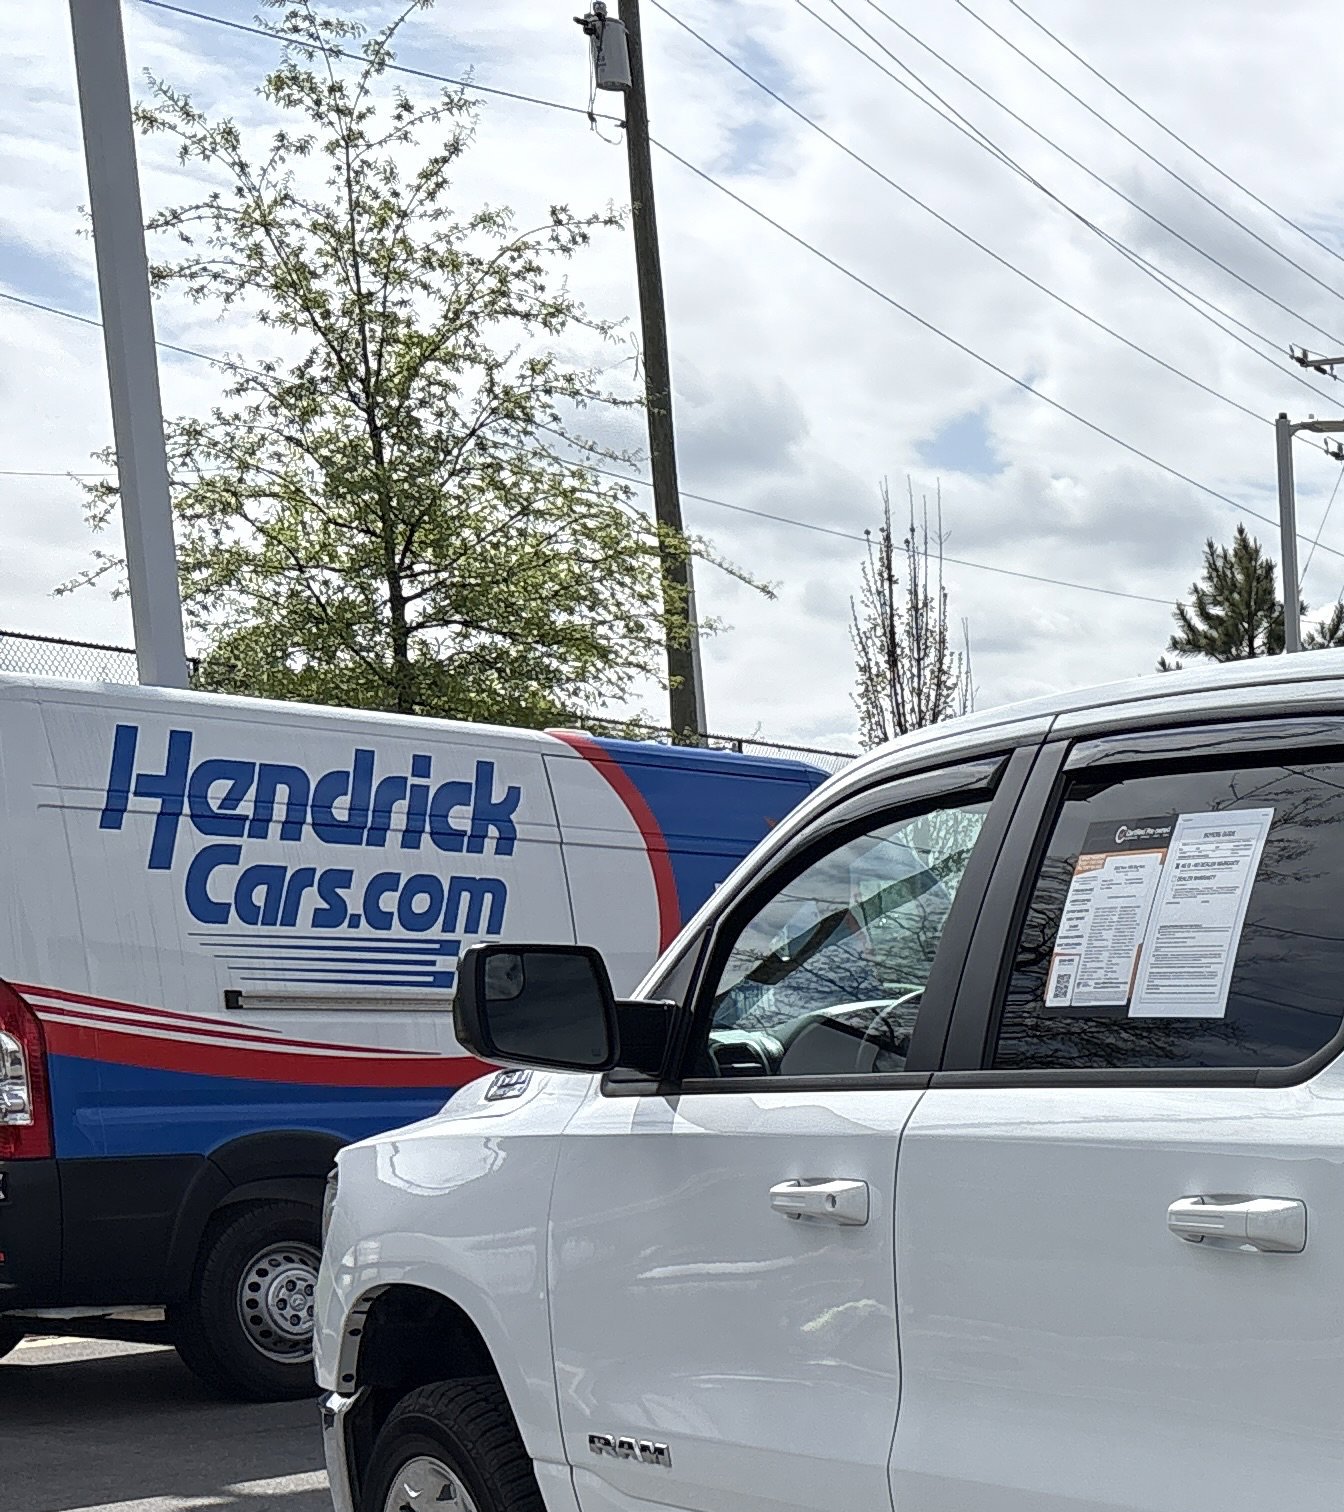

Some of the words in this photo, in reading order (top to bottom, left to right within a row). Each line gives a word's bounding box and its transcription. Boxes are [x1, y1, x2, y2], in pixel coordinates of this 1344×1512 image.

[99, 724, 521, 870] Hendrick
[185, 843, 508, 934] Cars.com
[588, 1433, 673, 1469] RAM
